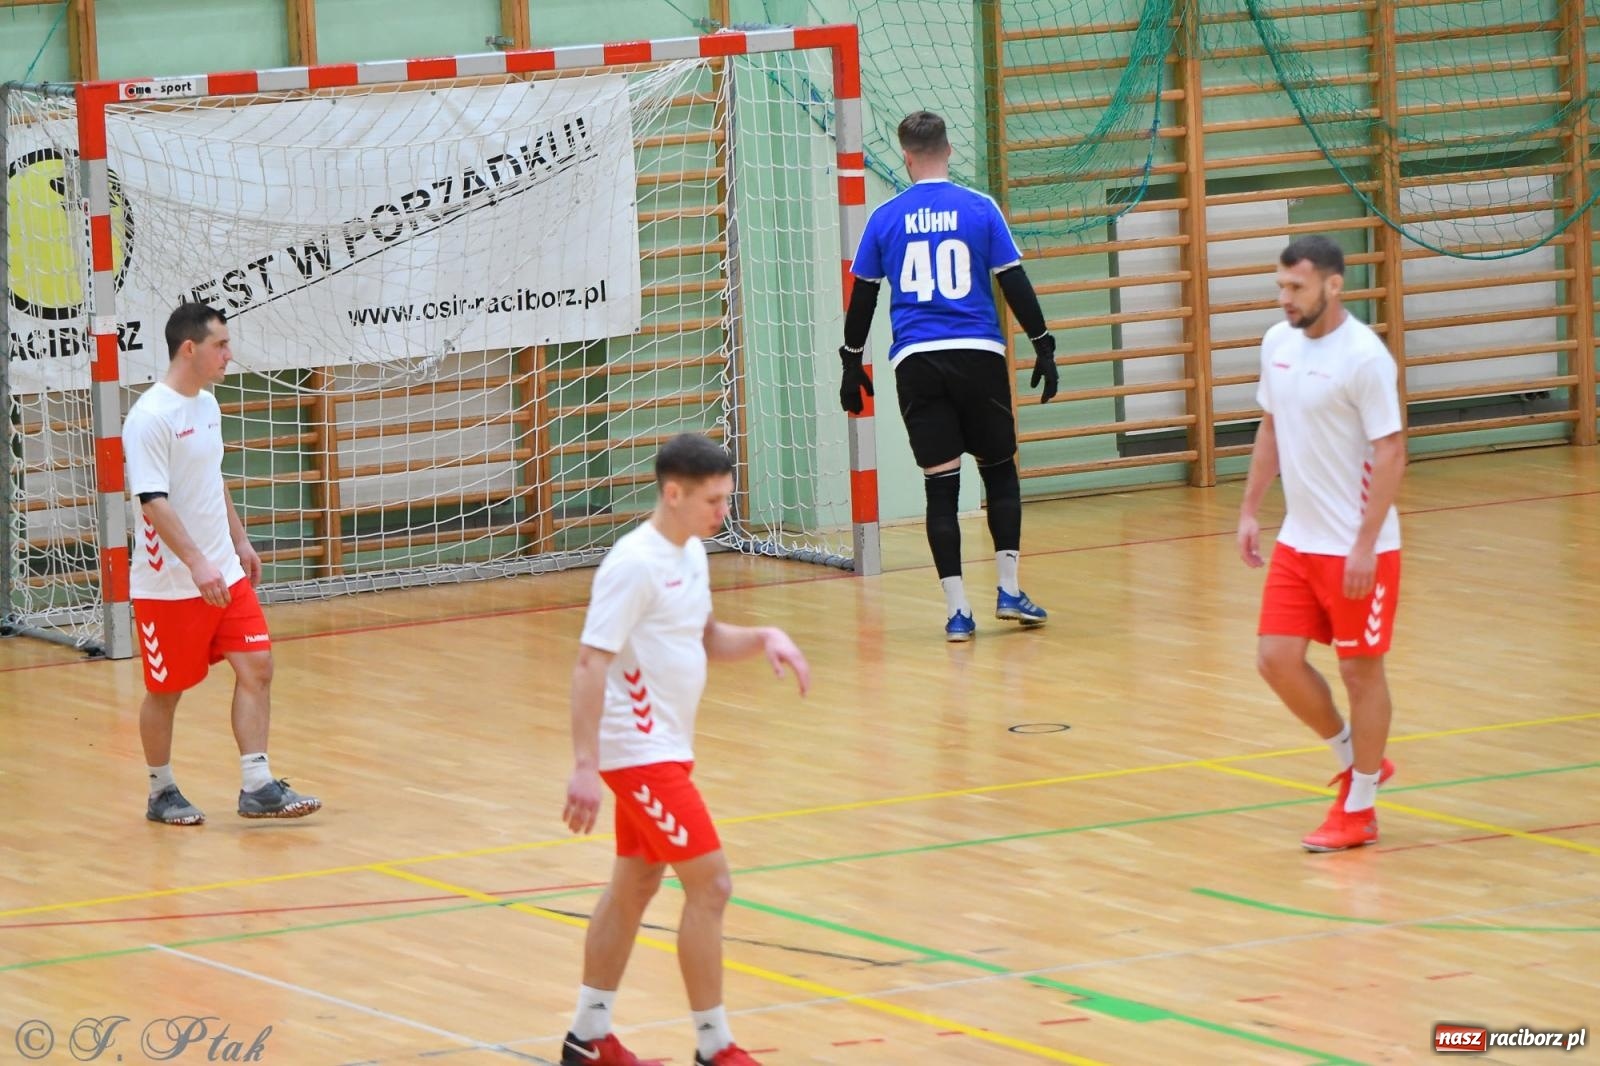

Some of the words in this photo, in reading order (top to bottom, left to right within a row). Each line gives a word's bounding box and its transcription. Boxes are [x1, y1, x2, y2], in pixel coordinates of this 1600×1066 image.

[160, 81, 192, 95] sport
[904, 207, 958, 235] KÜHN
[286, 233, 332, 280] W
[900, 238, 972, 303] 40
[347, 279, 607, 327] www.osir-raciborz.pl
